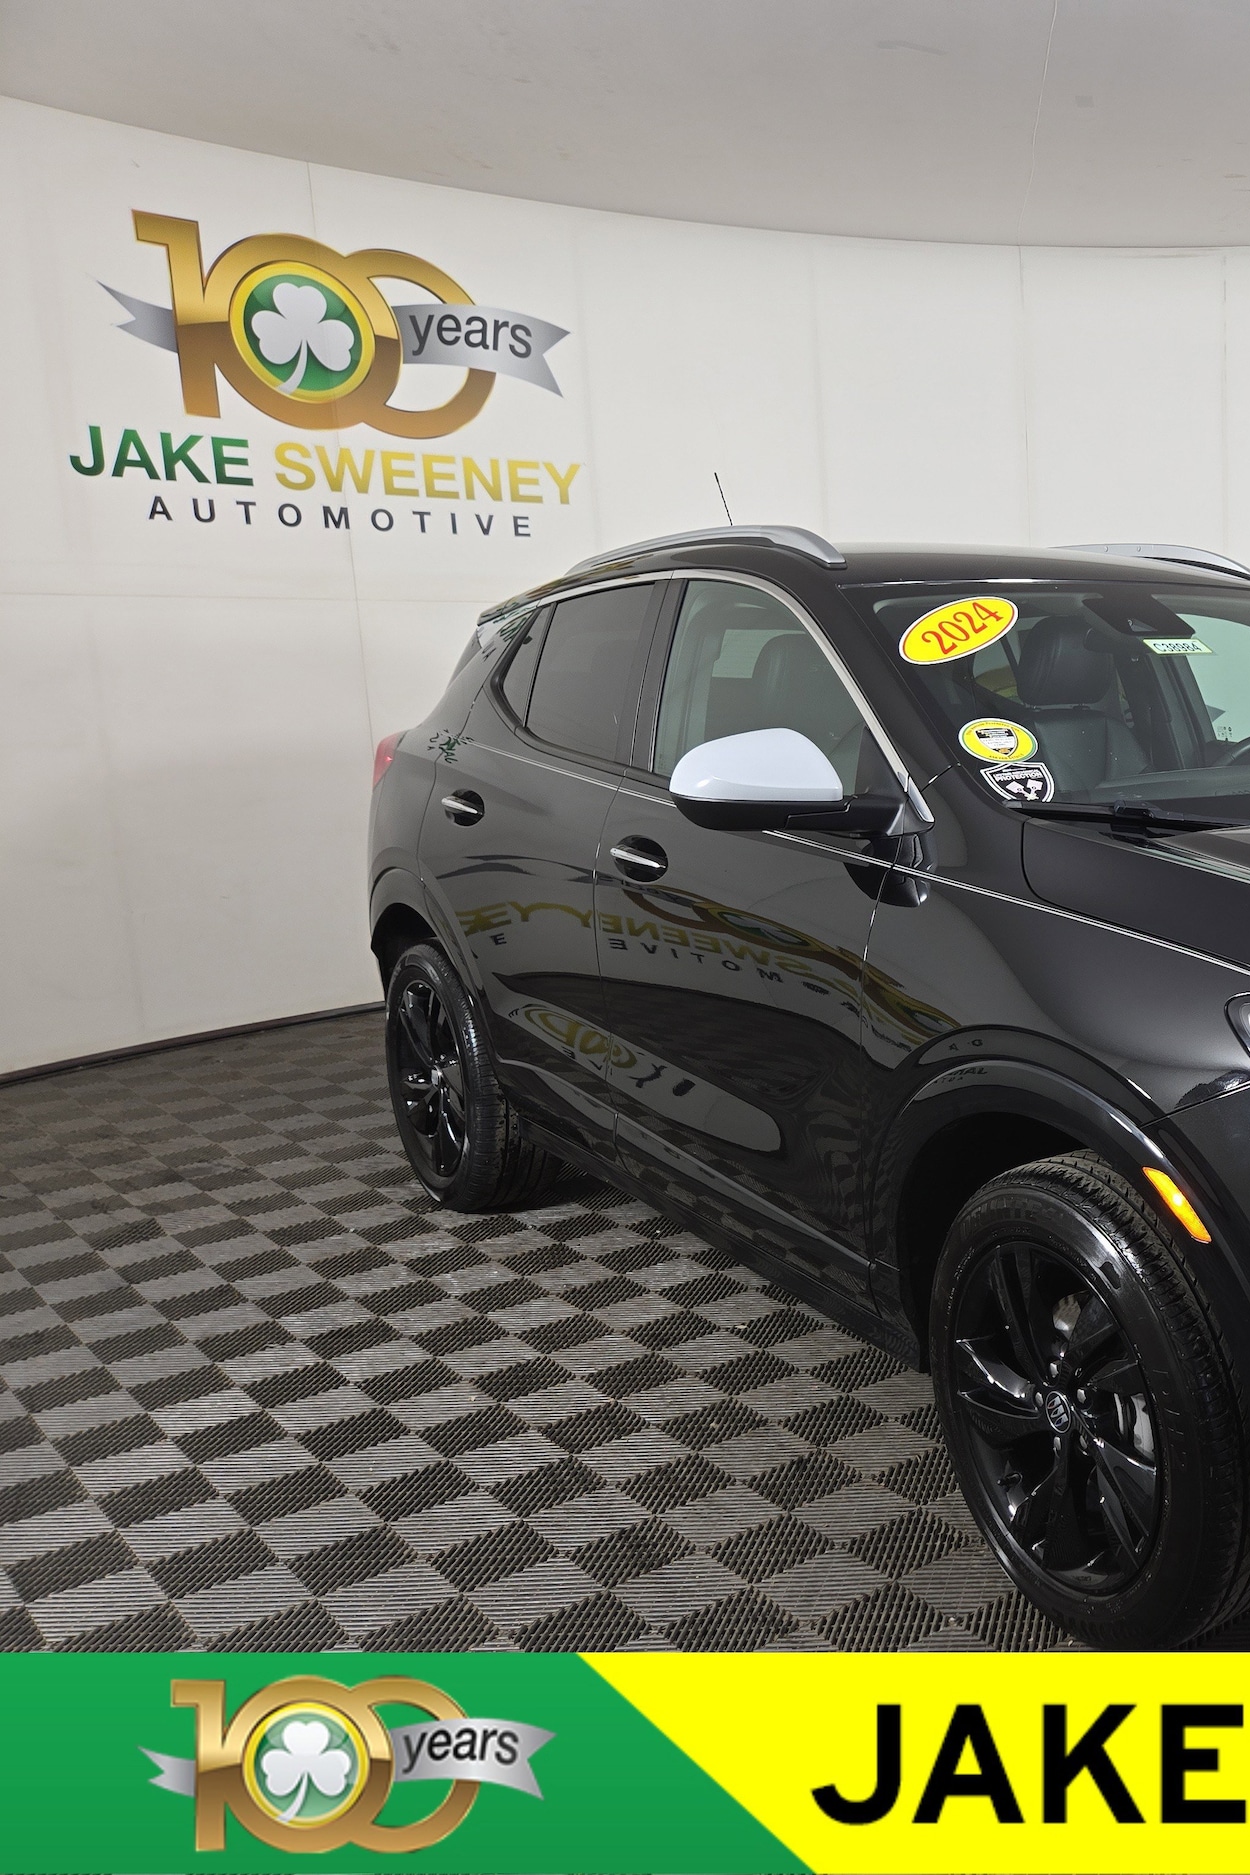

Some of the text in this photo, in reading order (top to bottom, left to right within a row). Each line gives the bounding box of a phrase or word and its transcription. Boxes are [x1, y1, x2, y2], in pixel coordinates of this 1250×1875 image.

[132, 209, 533, 439] 100 years
[69, 425, 581, 505] JAKE SWEENEY
[148, 495, 531, 537] AUTOMOTIVE
[921, 600, 1005, 655] 2024
